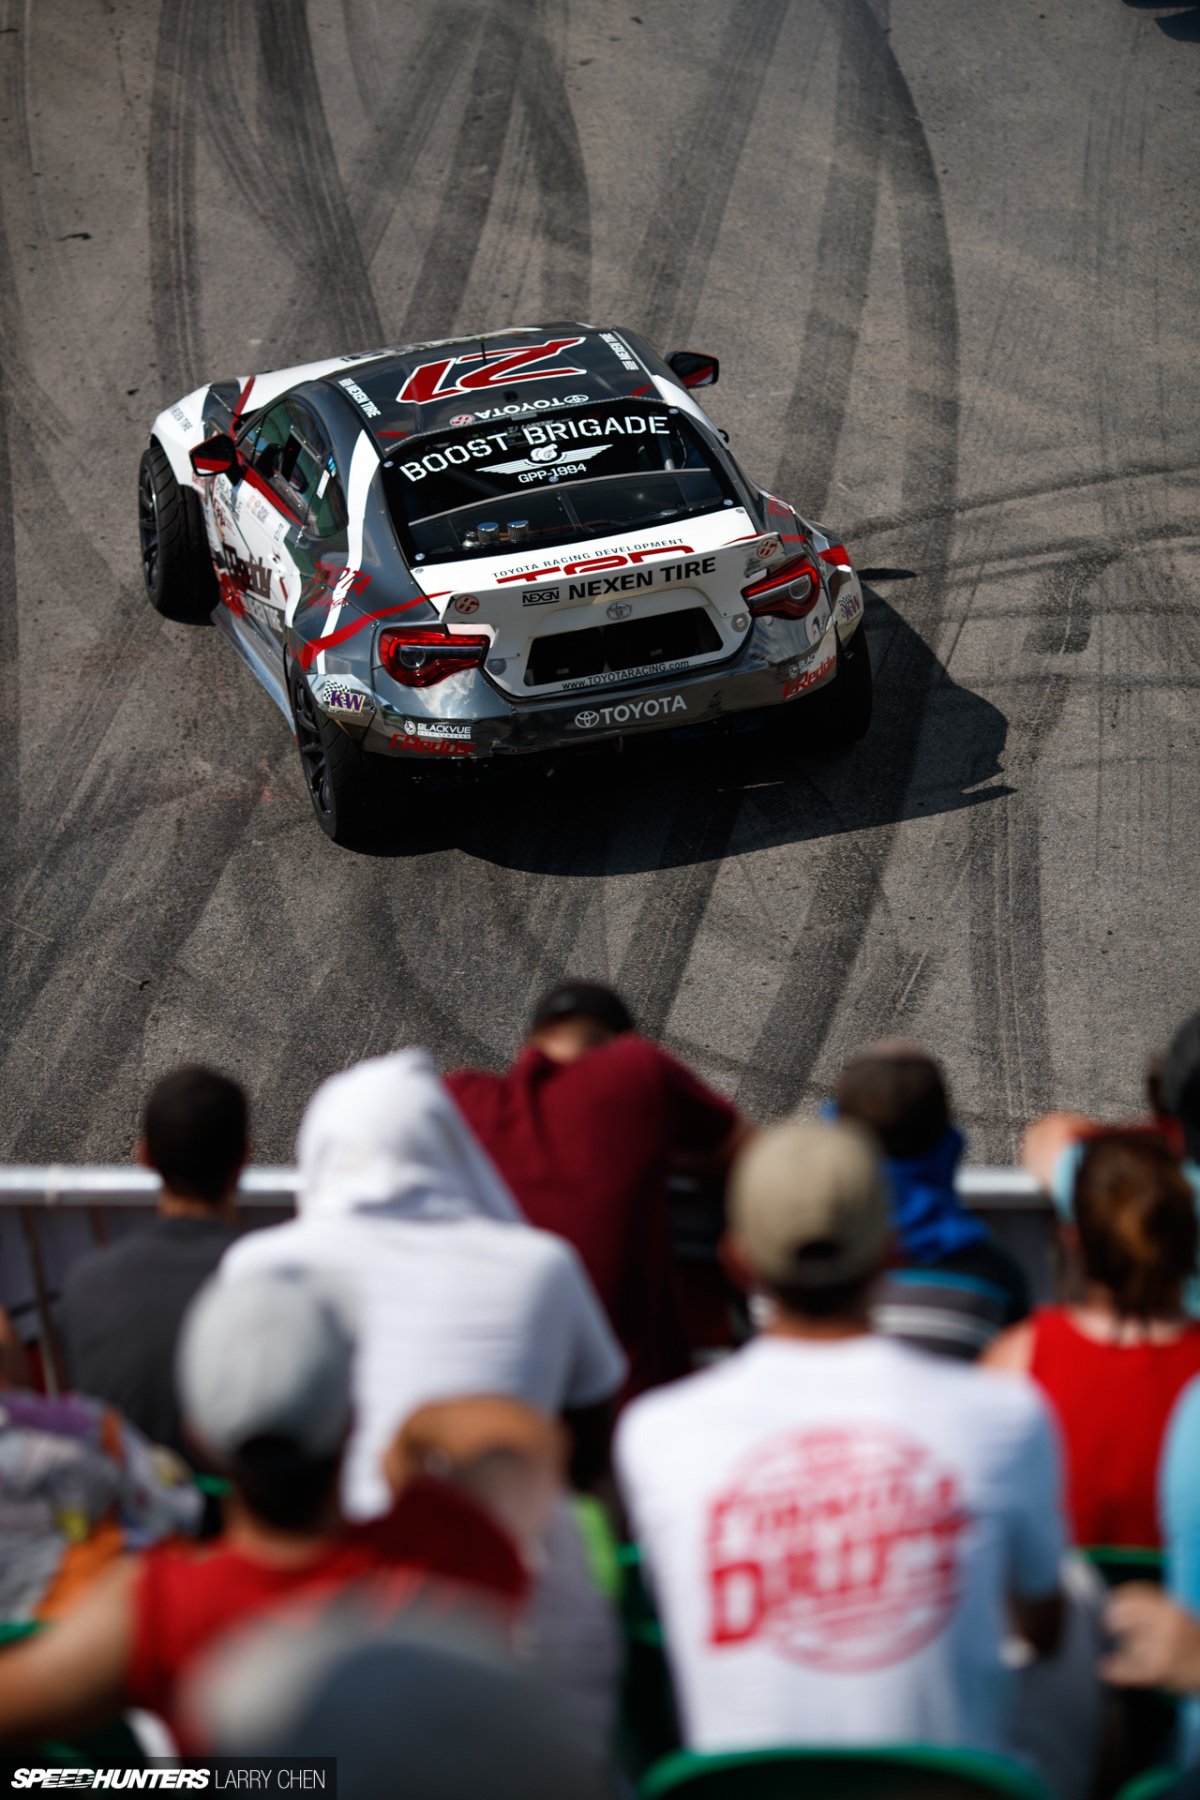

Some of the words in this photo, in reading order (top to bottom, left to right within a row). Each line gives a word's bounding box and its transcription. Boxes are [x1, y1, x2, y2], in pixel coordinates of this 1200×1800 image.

[396, 336, 586, 405] 21
[345, 382, 370, 405] NEXEN
[360, 398, 381, 418] TIRE
[474, 397, 564, 419] TOYOTA
[400, 432, 509, 482] BOOST
[522, 416, 671, 446] BRIGADE
[518, 463, 587, 483] GPP-1994
[493, 564, 539, 579] TOYOTA
[543, 552, 591, 567] RACING
[595, 538, 685, 557] DEVELOPMENT
[311, 561, 372, 597] TOYOTA
[569, 570, 653, 600] NEXEN
[660, 556, 716, 583] TIRE
[562, 660, 689, 690] www.TOYOTARACING.com
[330, 690, 365, 713] KW
[600, 695, 687, 724] TOYOTA
[417, 722, 471, 734] BLACKVUE
[390, 734, 475, 754] GReddy
